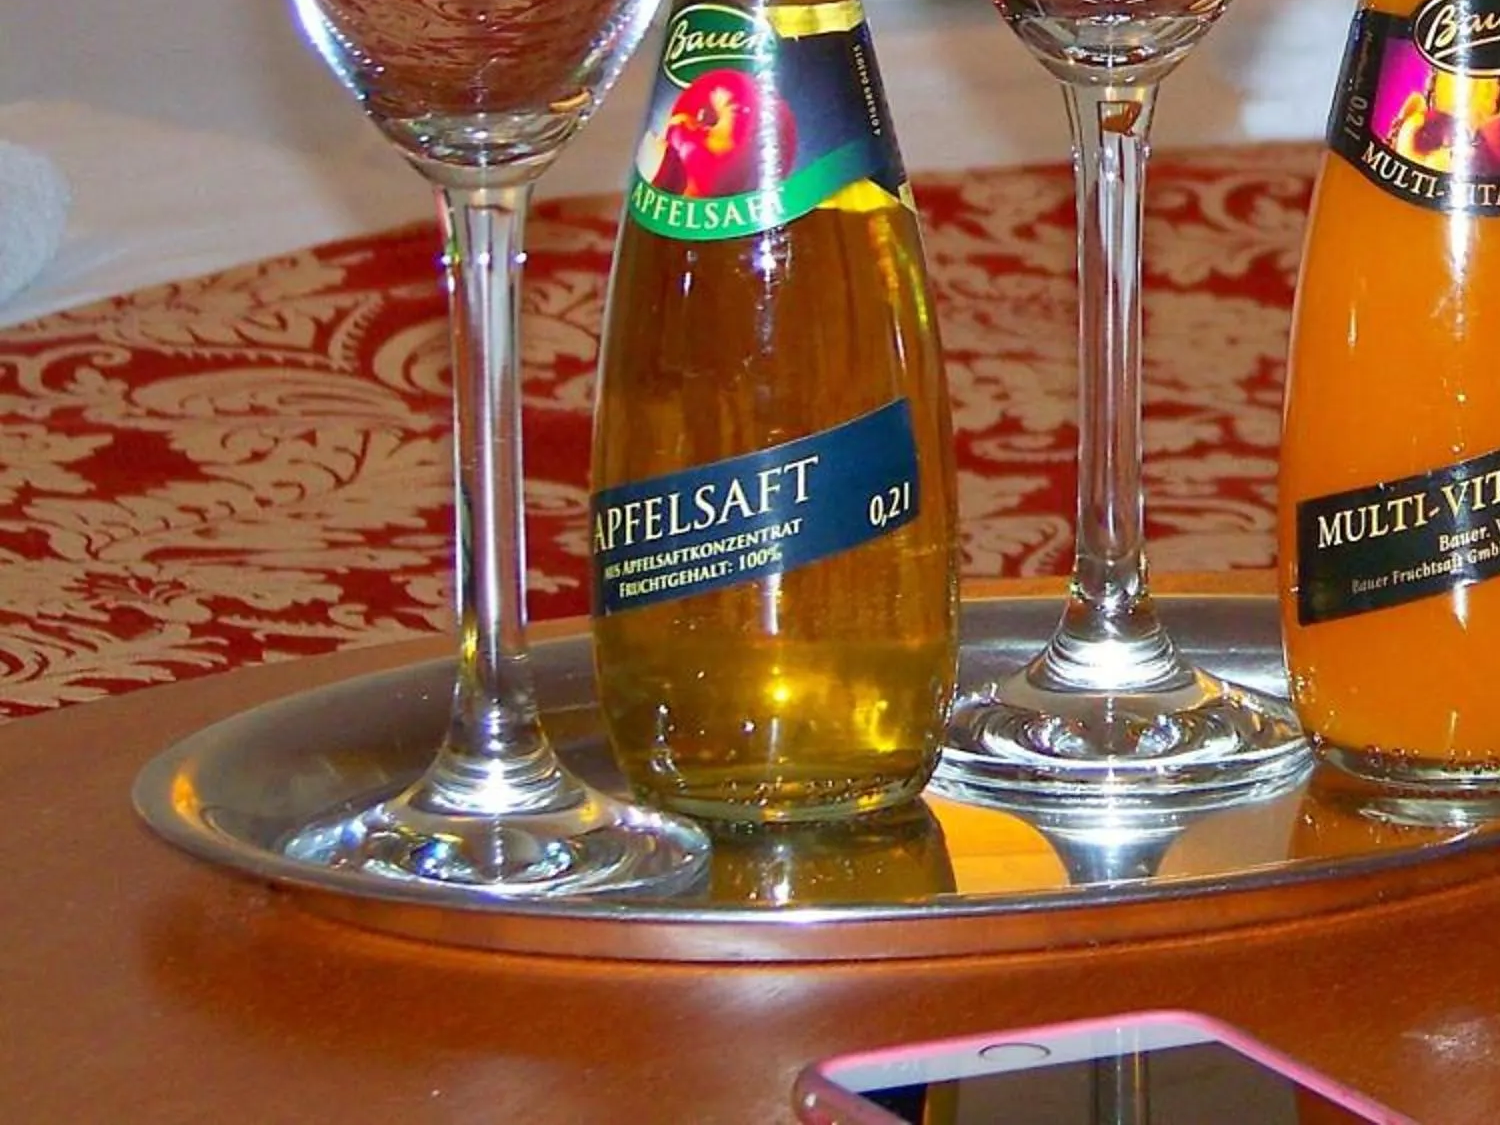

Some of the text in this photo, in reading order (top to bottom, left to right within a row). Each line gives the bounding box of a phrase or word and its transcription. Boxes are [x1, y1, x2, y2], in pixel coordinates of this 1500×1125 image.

[666, 19, 766, 62] Bauer
[631, 182, 786, 230] APFELSAFT
[592, 455, 820, 555] APFELSAFT
[622, 518, 803, 576] APFELSAFTKONZENTRAT
[1438, 527, 1491, 553] Bauer.
[618, 546, 783, 599] FRUCHTGEHALT: 100%
[1351, 575, 1389, 594] Bauer
[1392, 552, 1463, 586] Fruchtsaft
